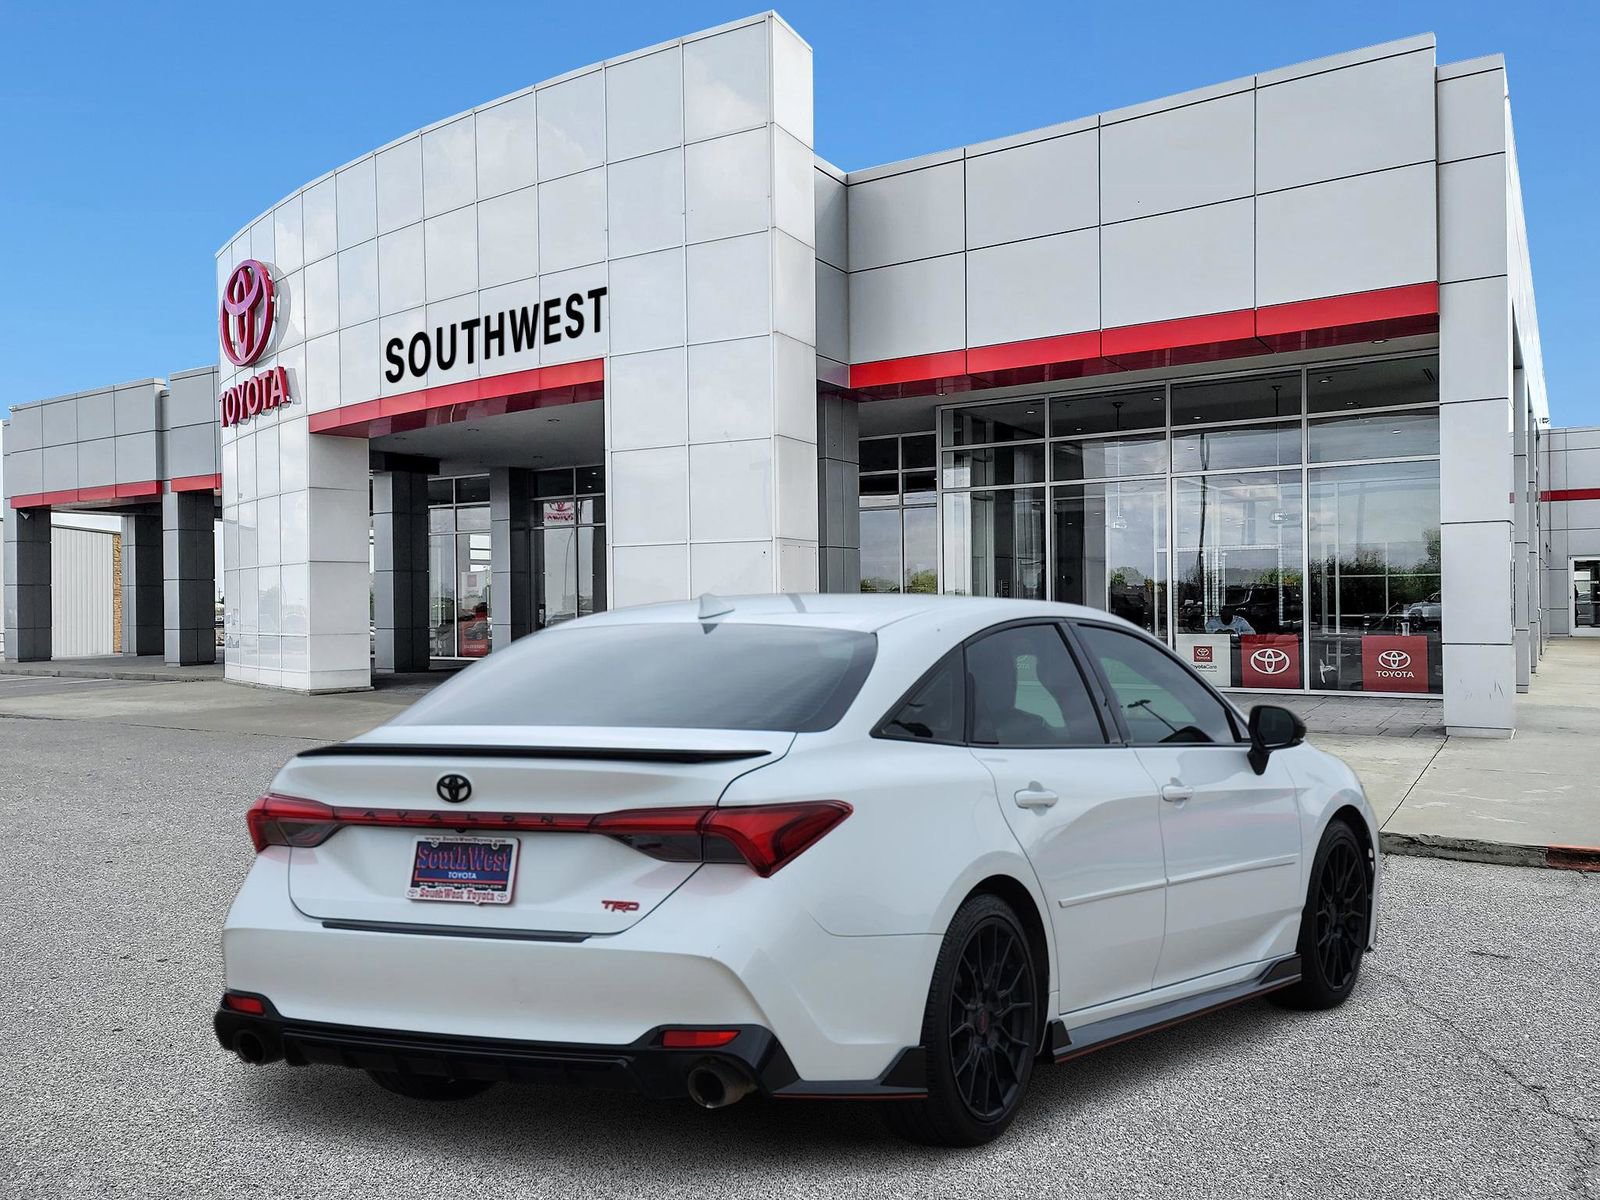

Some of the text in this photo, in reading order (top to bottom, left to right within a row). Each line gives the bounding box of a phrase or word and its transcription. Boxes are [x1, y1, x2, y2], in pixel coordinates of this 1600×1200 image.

[385, 286, 608, 384] SOUTHWEST
[218, 365, 289, 428] TOYOTA
[1375, 670, 1414, 678] TOYOTA
[364, 810, 554, 825] AVALON
[448, 871, 477, 879] TOYOTA
[467, 889, 495, 902] Toyota
[601, 900, 640, 913] TRD
